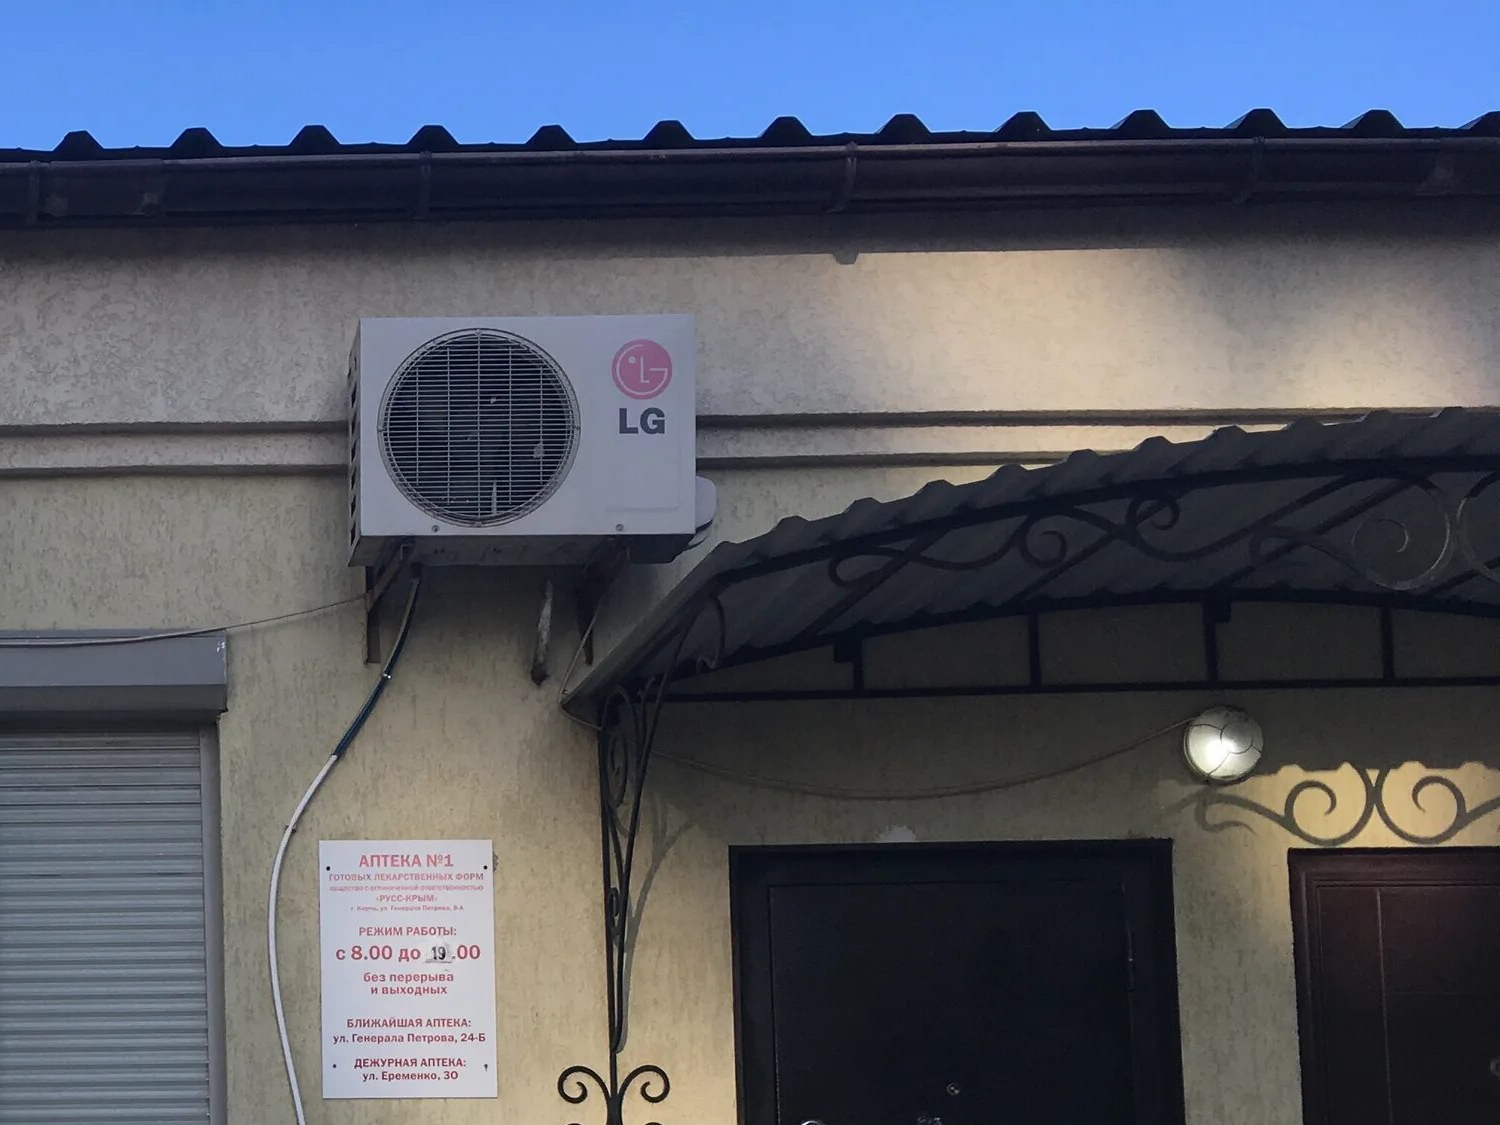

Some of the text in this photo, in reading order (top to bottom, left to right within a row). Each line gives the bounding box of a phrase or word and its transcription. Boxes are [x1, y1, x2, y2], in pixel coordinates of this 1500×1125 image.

[618, 407, 666, 435] LG
[358, 854, 454, 868] АПТЕКА №1
[328, 872, 484, 881] ГОТОВЫХ ЛЕКАРСТВЕННЫХ ФОРМ
[358, 926, 457, 936] РЕЖИМ РАБОТЫ:
[335, 949, 346, 961] с
[350, 945, 393, 961] 8.00
[398, 948, 421, 962] до
[363, 972, 454, 984] без перерыва
[370, 986, 448, 996] и выходных
[346, 1017, 472, 1028] БЛИЖАЙШАЯ АПТЕКА:
[332, 1032, 486, 1044] ул. Генерала Петрова, 24-Б
[354, 1058, 467, 1069] ДЕЖУРНАЯ АПТЕКА:
[362, 1073, 378, 1082] ул.
[381, 1071, 441, 1082] Еременко,
